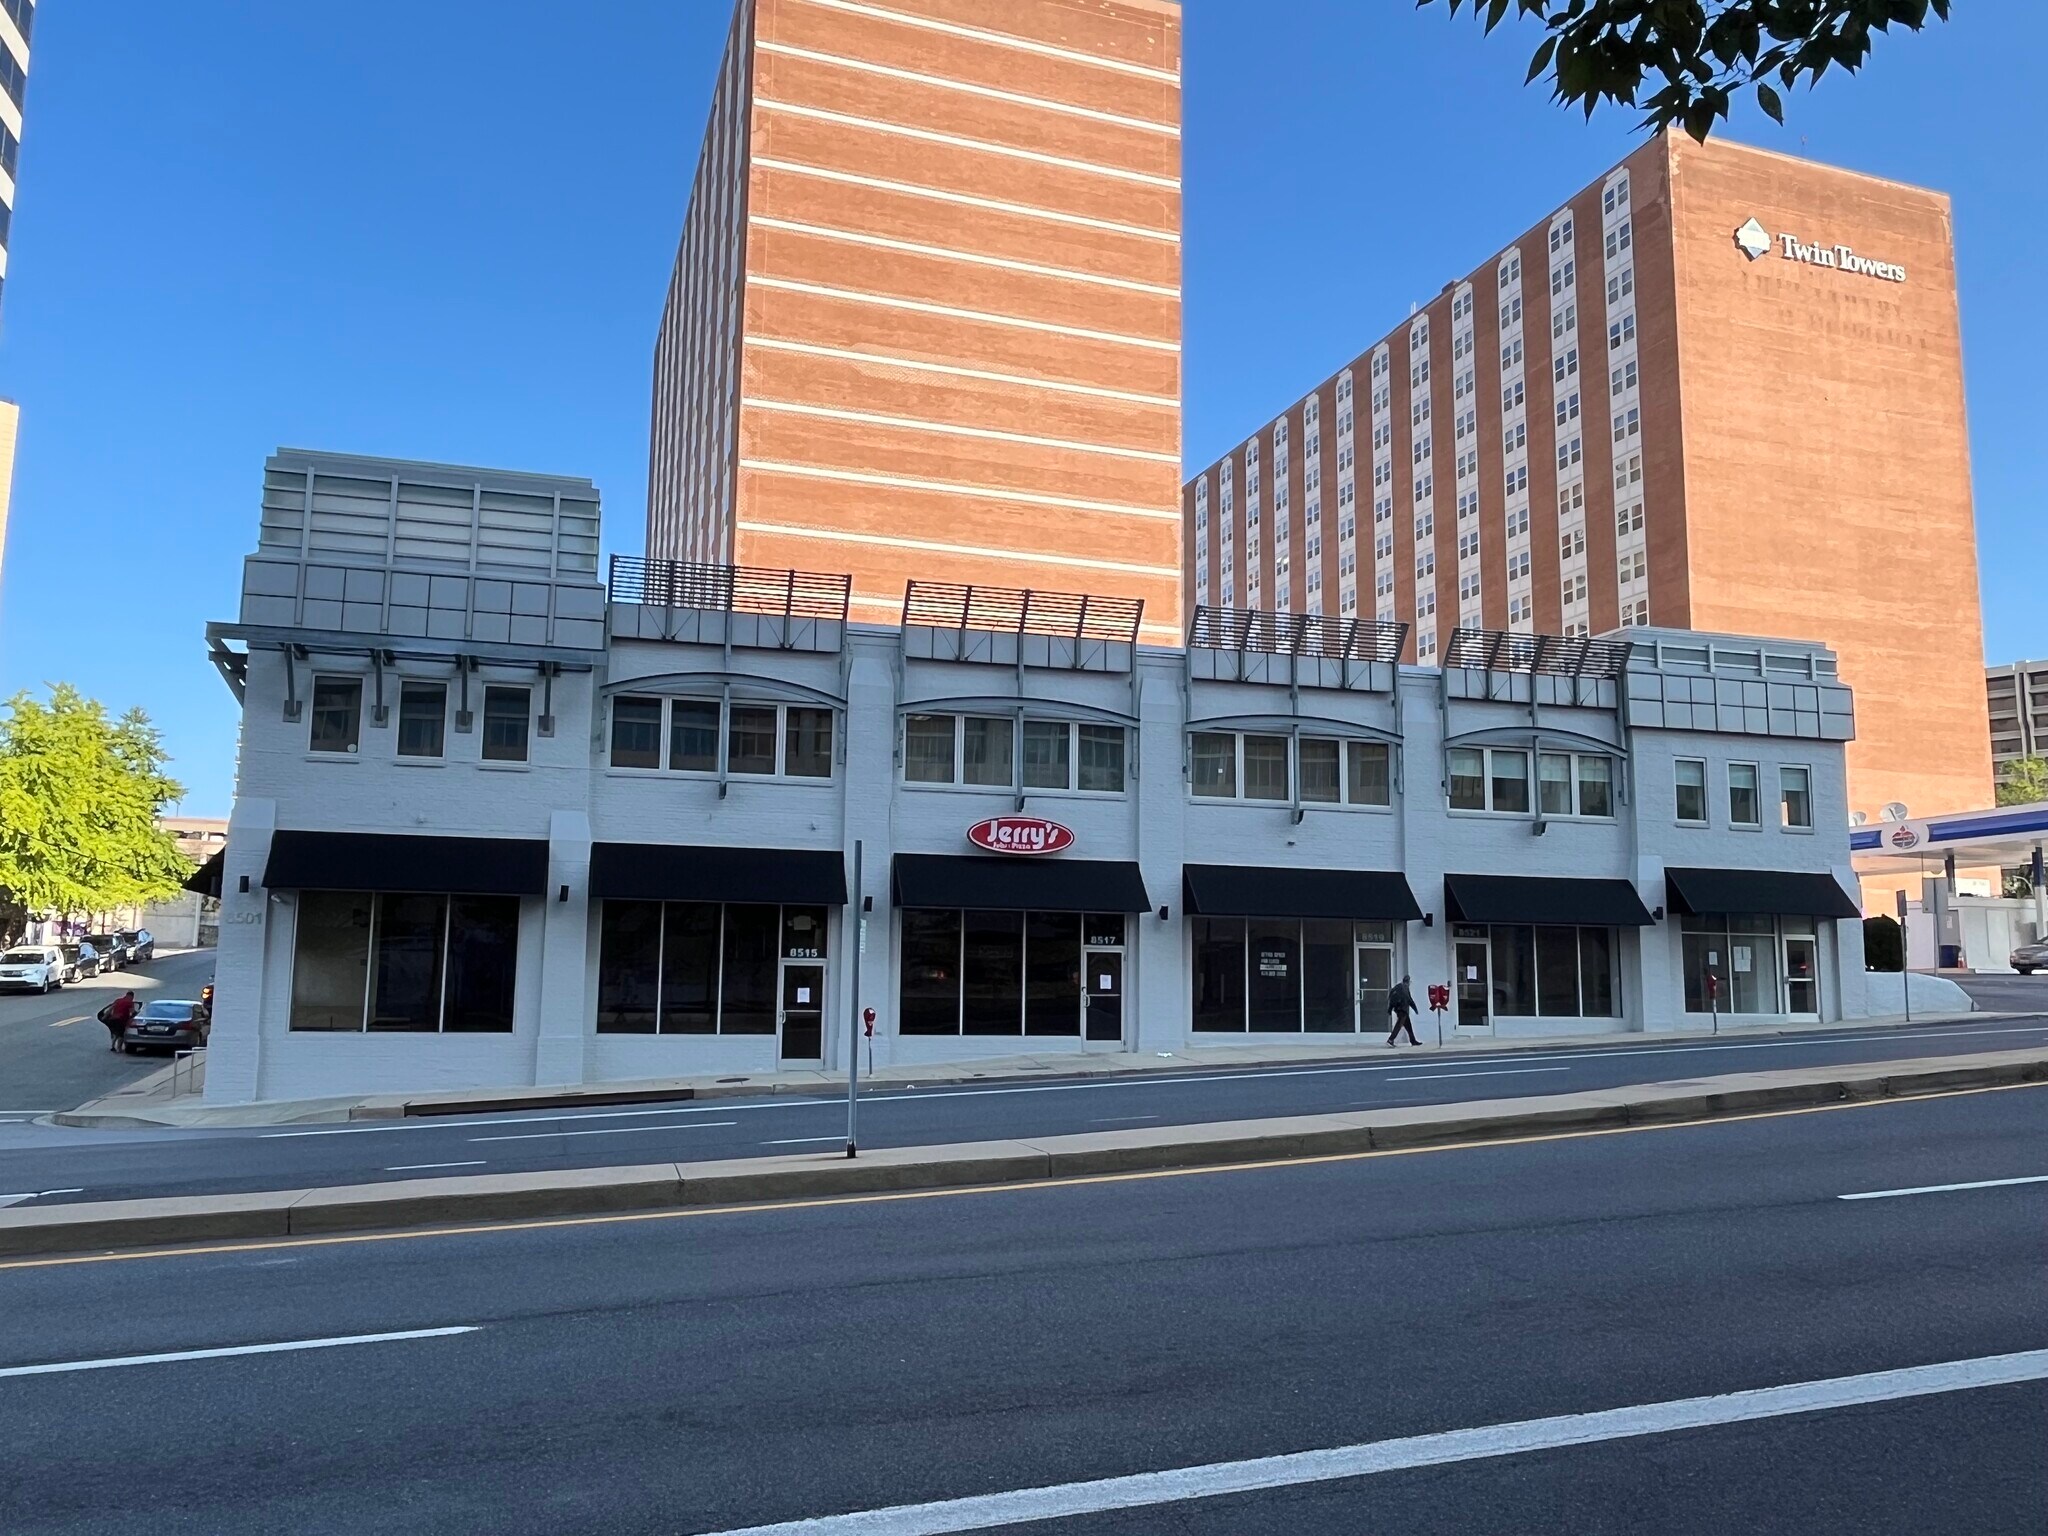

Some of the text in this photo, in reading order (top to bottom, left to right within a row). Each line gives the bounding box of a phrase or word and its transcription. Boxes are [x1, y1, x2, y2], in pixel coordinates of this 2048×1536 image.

[1778, 233, 1907, 282] Twin Towers
[987, 820, 1059, 850] Jerry's
[1011, 842, 1031, 850] Pizza
[1090, 936, 1116, 945] 8517
[789, 948, 818, 958] 8515
